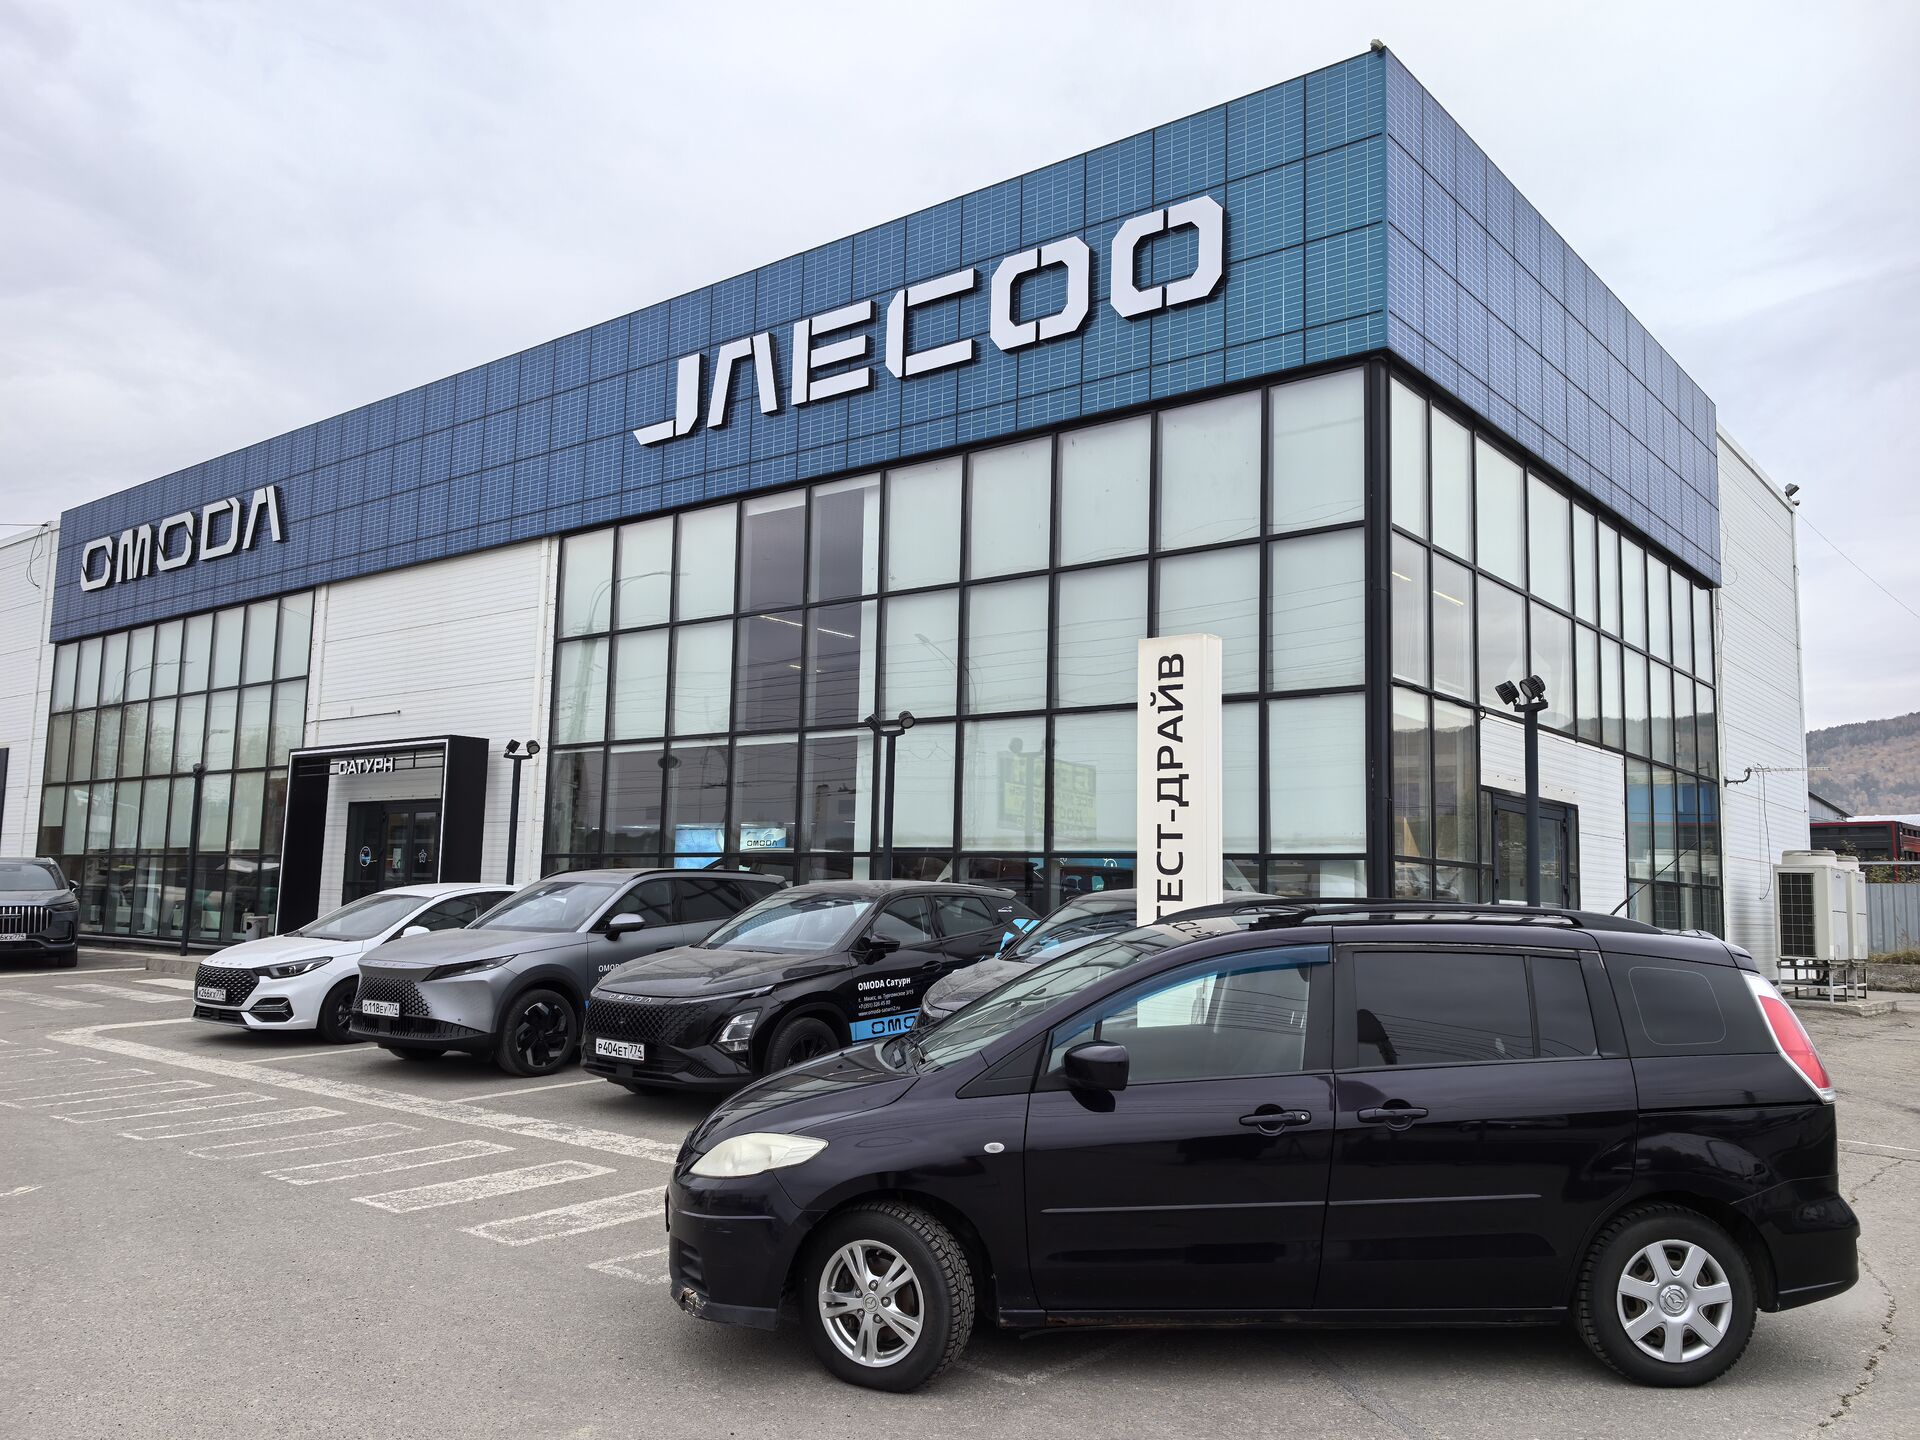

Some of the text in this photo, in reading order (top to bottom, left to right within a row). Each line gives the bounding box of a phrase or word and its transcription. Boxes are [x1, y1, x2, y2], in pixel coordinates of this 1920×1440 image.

[632, 195, 1224, 447] JAECOO
[80, 485, 281, 592] OMODA
[338, 757, 394, 775] САТУРН
[746, 839, 778, 847] OMODA
[858, 977, 911, 991] OMODA Сатурн
[609, 993, 652, 1003] OMODA
[598, 1041, 642, 1057] Р404ЕТ 774
